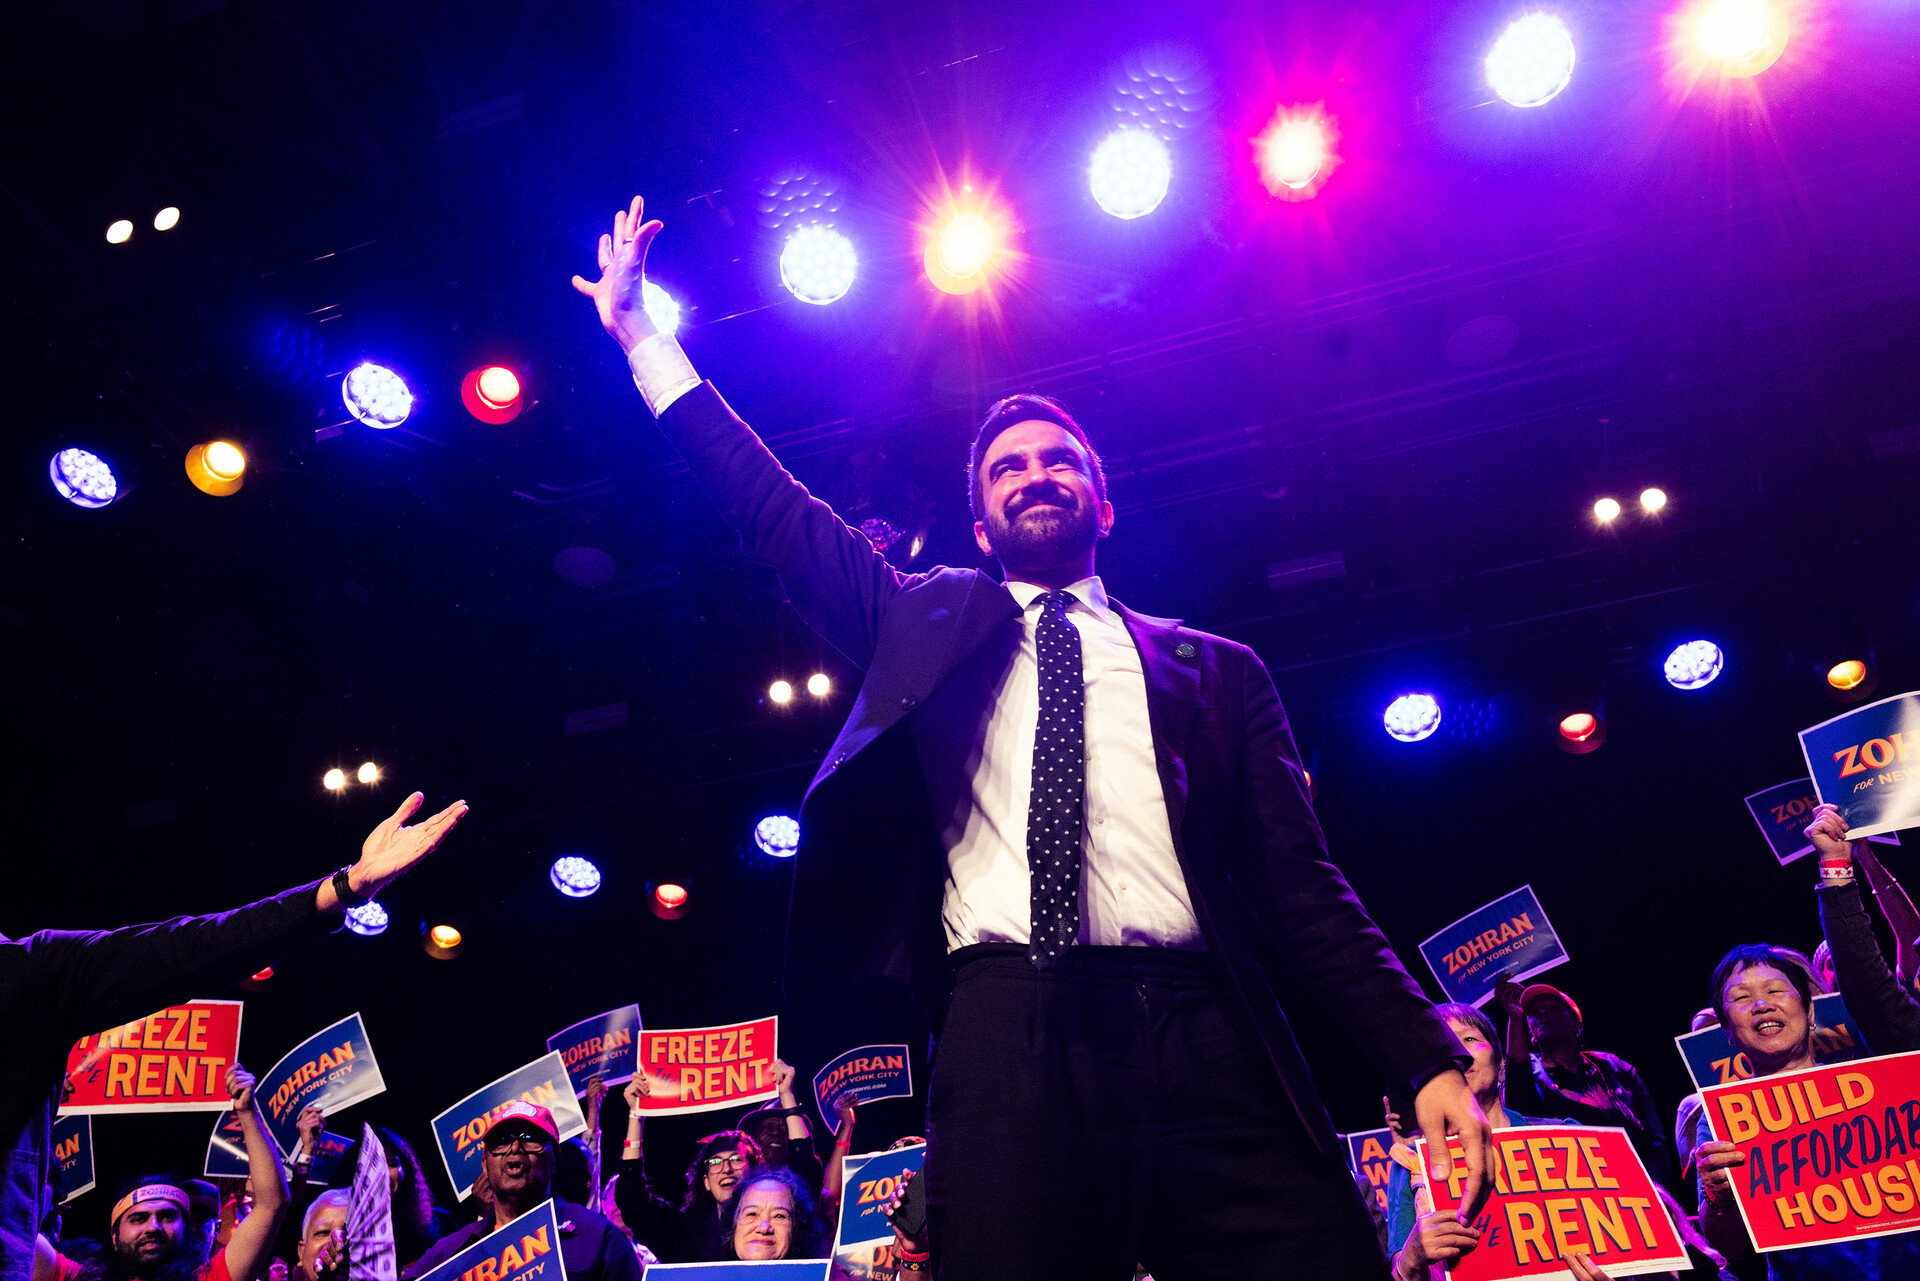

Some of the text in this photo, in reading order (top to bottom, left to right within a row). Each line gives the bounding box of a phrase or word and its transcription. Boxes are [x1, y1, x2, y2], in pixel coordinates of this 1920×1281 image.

[1853, 778, 1875, 793] FOR
[1442, 912, 1535, 976] ZOHRAN
[1467, 959, 1486, 976] NEW
[1487, 945, 1512, 962] YORK
[1512, 934, 1534, 950] CITY
[650, 1027, 754, 1065] FREEZE
[104, 1053, 226, 1099] RENT
[268, 1040, 356, 1120] ZOHRAN
[300, 1076, 327, 1097] YORK
[328, 1064, 353, 1082] CITY
[679, 1057, 769, 1102] RENT
[818, 1055, 904, 1101] ZOHRAN
[849, 1073, 875, 1083] YORK
[877, 1071, 899, 1080] CITY
[1718, 1072, 1875, 1146] BUILD
[1475, 1197, 1658, 1266] HE RENT
